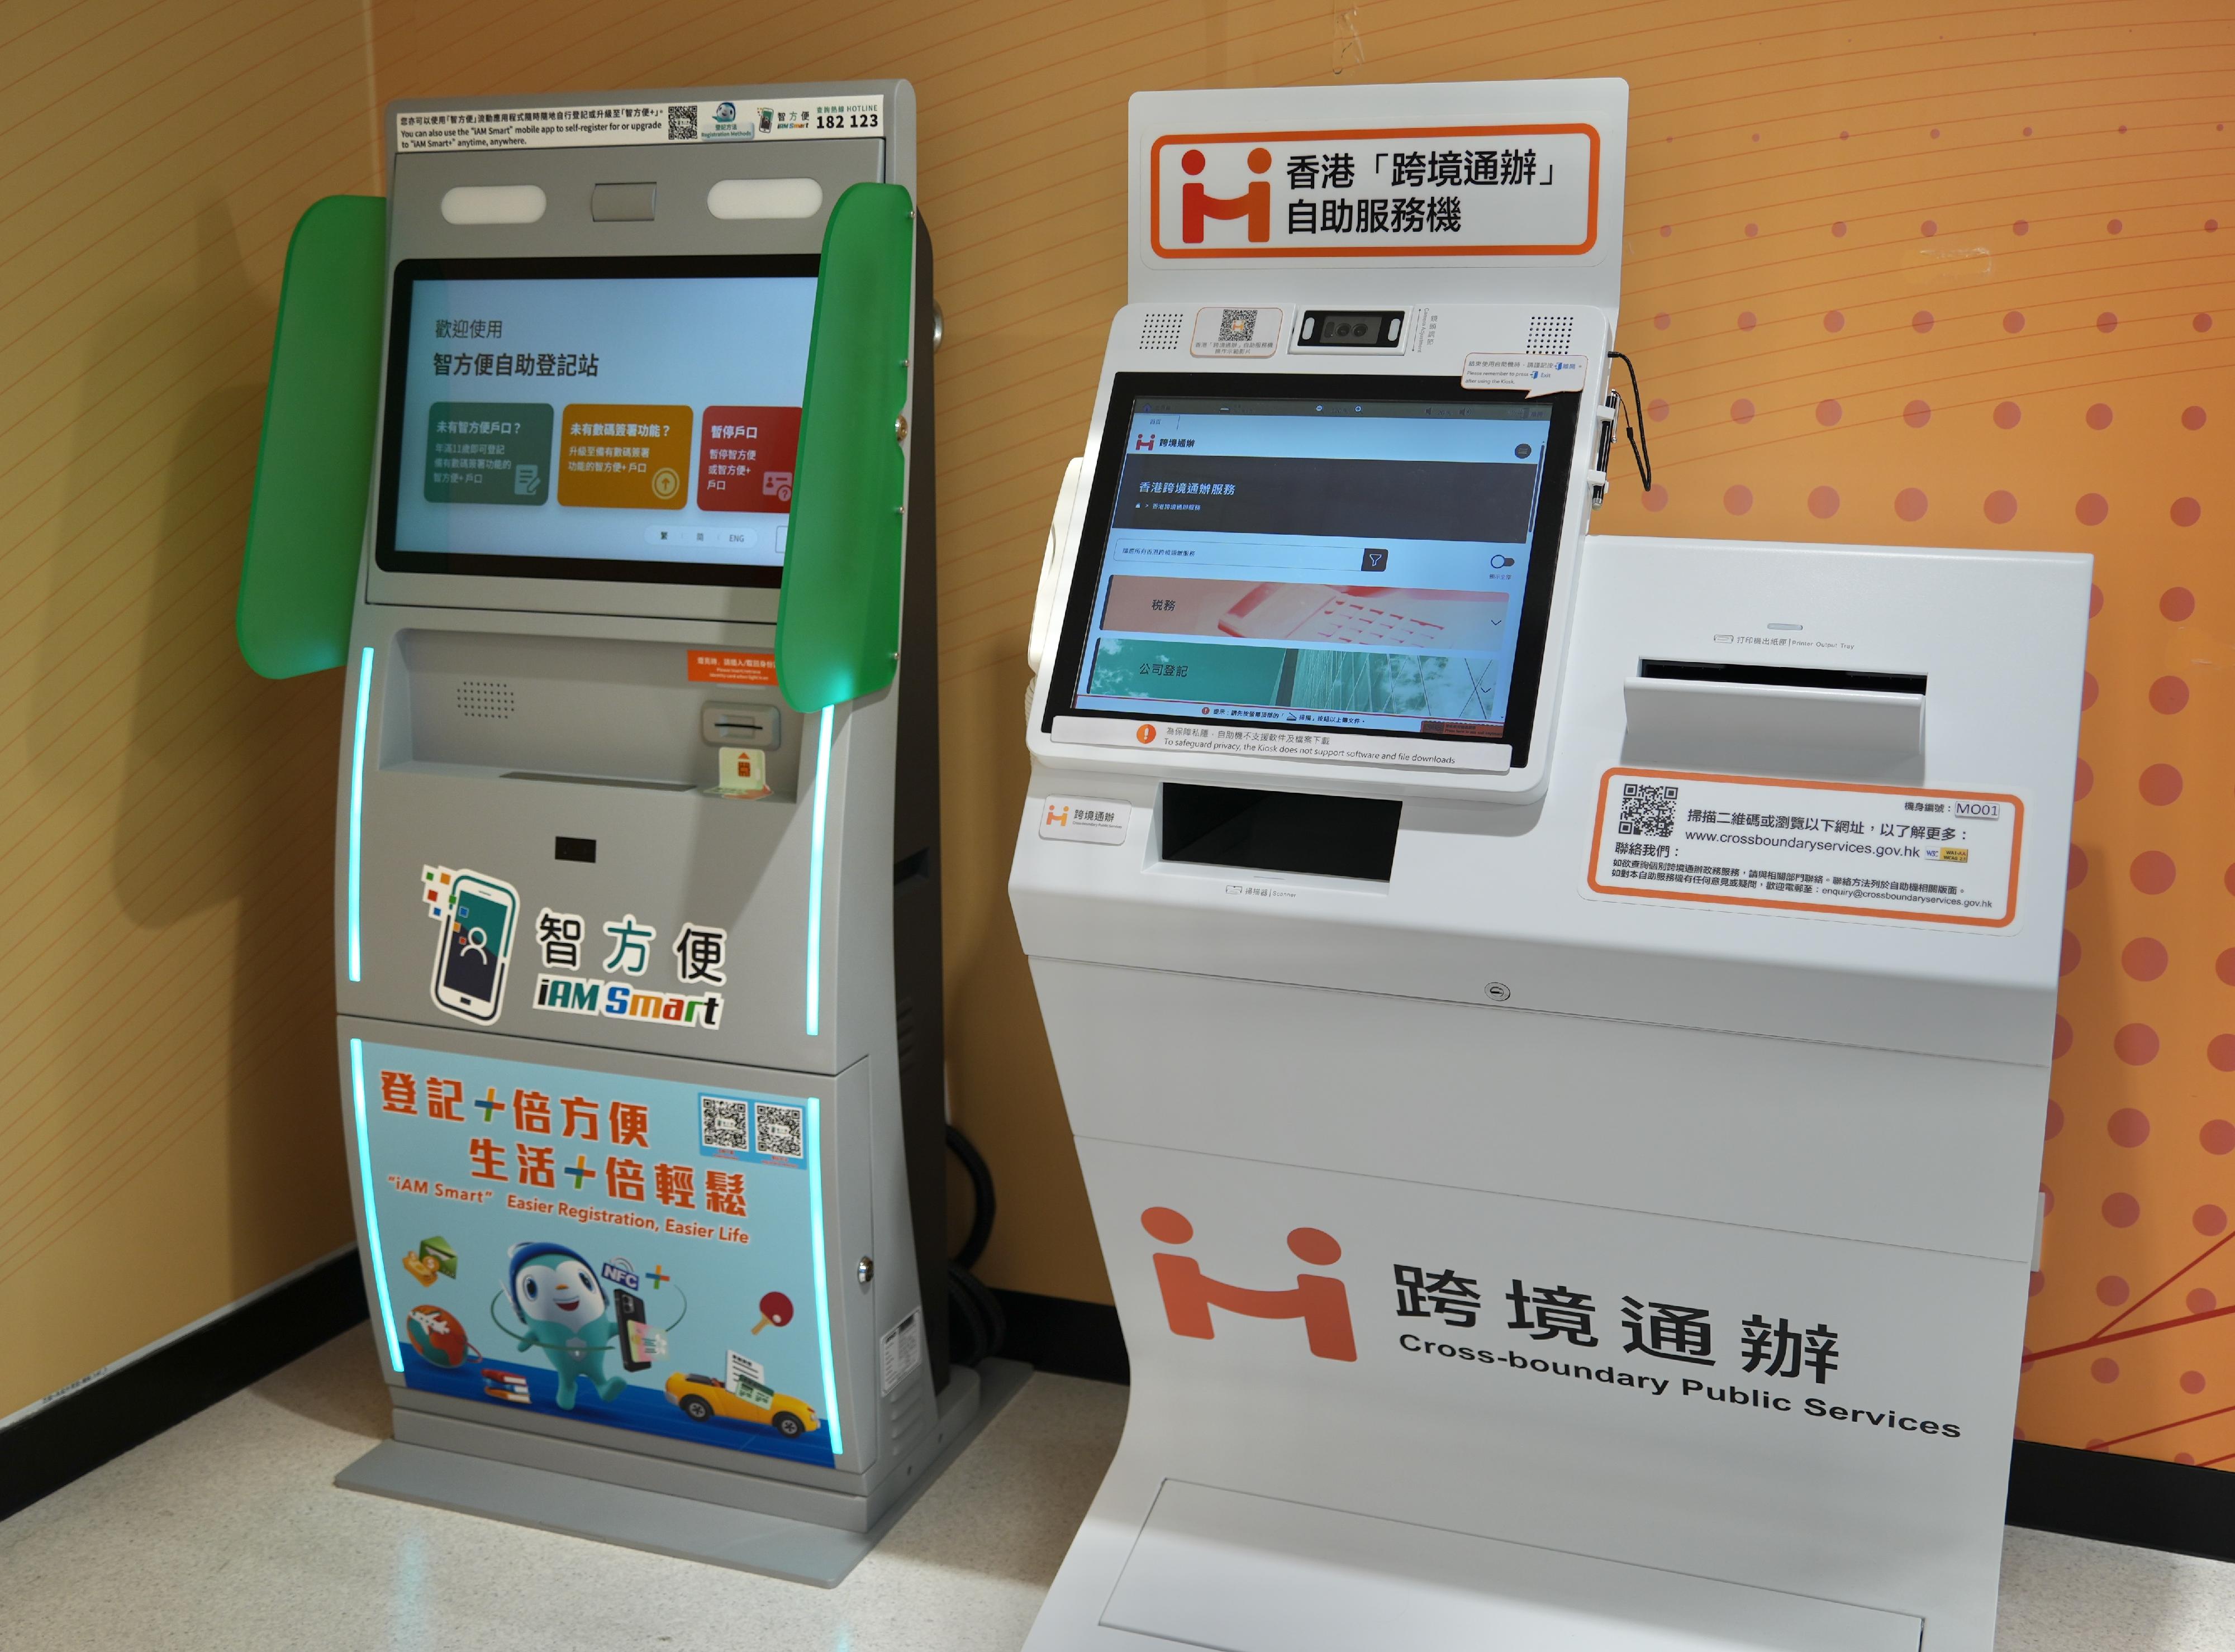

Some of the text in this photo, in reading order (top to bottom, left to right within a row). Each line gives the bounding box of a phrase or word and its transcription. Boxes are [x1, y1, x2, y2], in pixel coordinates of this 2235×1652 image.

[778, 111, 810, 121] 智方便
[817, 114, 878, 128] 182 123
[515, 125, 539, 134] mobile
[565, 123, 608, 133] self-register
[631, 121, 662, 131] upgrade
[458, 138, 488, 148] anytime,
[490, 138, 526, 147] anywhere.
[1287, 149, 1555, 191] 香港「跨境通辦」
[1288, 196, 1462, 235] 自助服務機
[436, 320, 502, 339] 歡迎使用
[434, 353, 599, 377] 智方便自助登記站
[711, 425, 758, 439] 暫停戶口
[1159, 438, 1195, 448] 跨境通辦
[710, 449, 756, 461] 暫停智方便
[708, 464, 751, 476] 或智方便+
[707, 479, 726, 490] 戶口
[1139, 482, 1236, 496] 香港跨境通辦服務
[729, 534, 744, 542] ENG
[1139, 663, 1188, 677] 公司登記
[1175, 739, 1211, 749] safeguard
[1214, 742, 1242, 751] privacy,
[1258, 744, 1277, 752] Kiosk
[1314, 749, 1344, 758] support
[1347, 750, 1380, 759] software
[1381, 752, 1396, 760] and
[1412, 754, 1455, 764] downloads
[1073, 809, 1115, 822] 跨境通辦
[1687, 809, 1966, 841] 掃描二維碼或瀏覽以下網址，以了解更多：
[1615, 842, 1678, 858] 聯絡我們：
[1685, 831, 1920, 858] www.crossboundaryservices.gov.hk
[1245, 887, 1268, 897] 掃描器
[539, 913, 725, 982] 智方便
[539, 978, 721, 1026] iAM Smart
[507, 1194, 554, 1214] Easier
[559, 1202, 659, 1232] Registration,
[665, 1218, 715, 1239] Easier
[719, 1226, 749, 1244] Life
[603, 1264, 638, 1288] NFC
[1392, 1263, 1840, 1386] 跨境通辦
[1398, 1334, 1962, 1440] Cross-boundary Public Services
